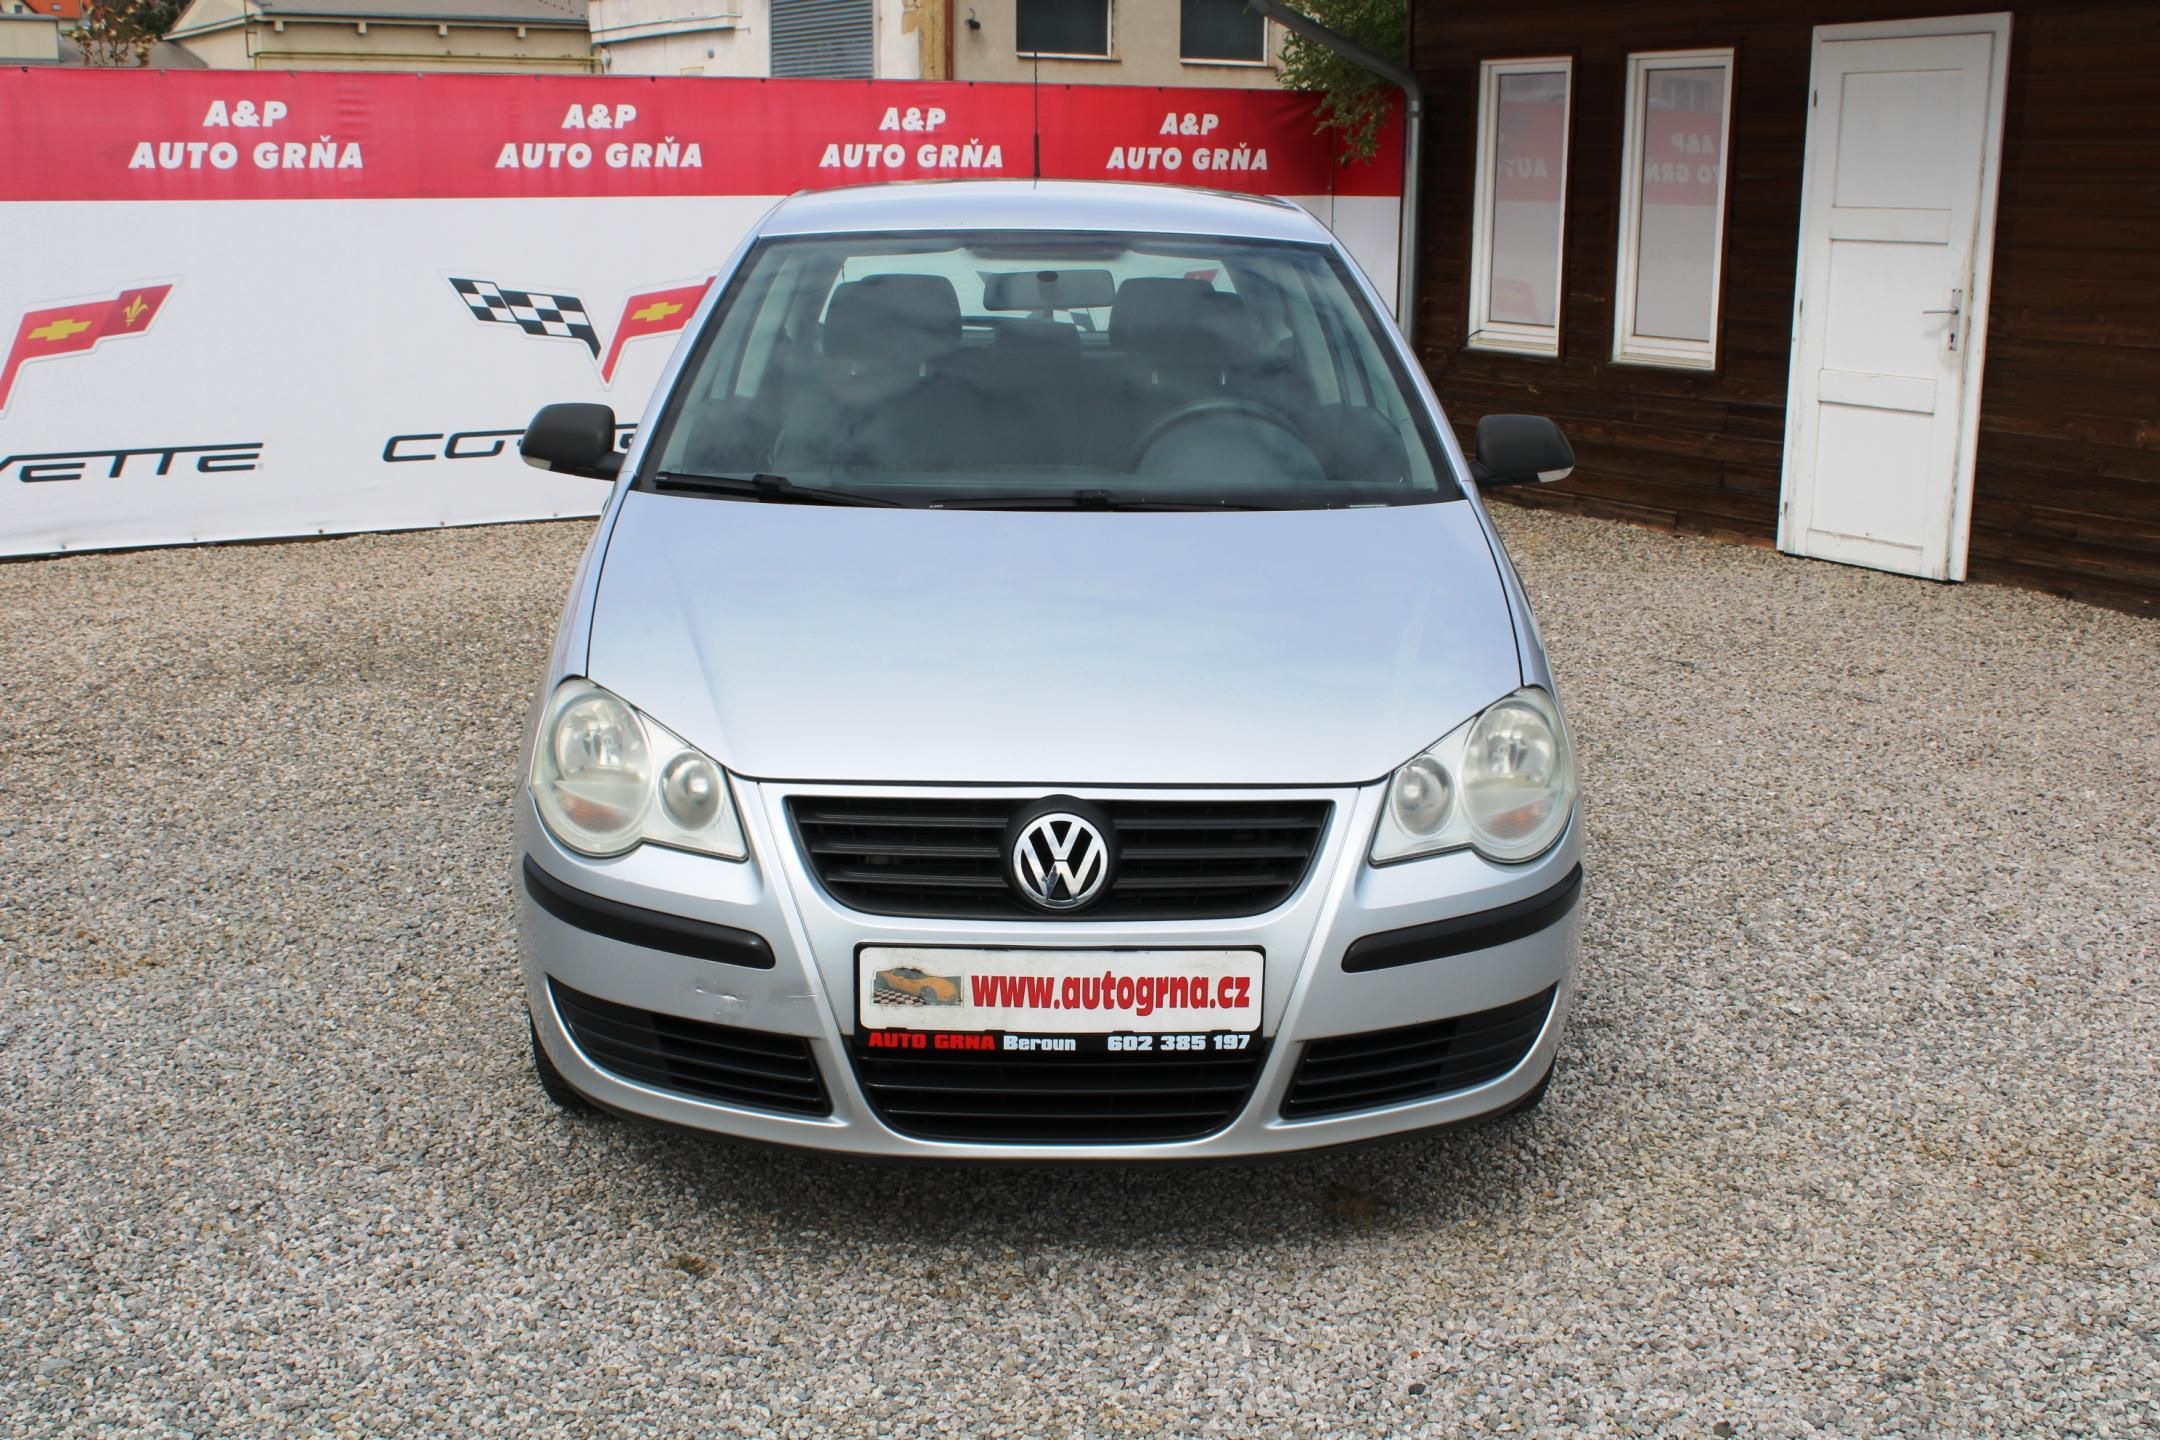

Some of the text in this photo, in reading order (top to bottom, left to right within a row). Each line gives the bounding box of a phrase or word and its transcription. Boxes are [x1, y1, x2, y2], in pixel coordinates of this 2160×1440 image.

[202, 99, 288, 128] A&P
[561, 103, 637, 130] A&P
[878, 107, 946, 132] A&P
[1159, 113, 1219, 135] A&P
[127, 134, 364, 170] AUTO GRŇA
[495, 135, 703, 169] AUTO GRŇA
[819, 138, 1003, 169] AUTO GRŇA
[1106, 142, 1267, 170] AUTO GRŇA
[971, 971, 1251, 1017] www.autogrna.cz
[868, 1032, 1251, 1051] AUTO GRNA Beroun 602 385 197
